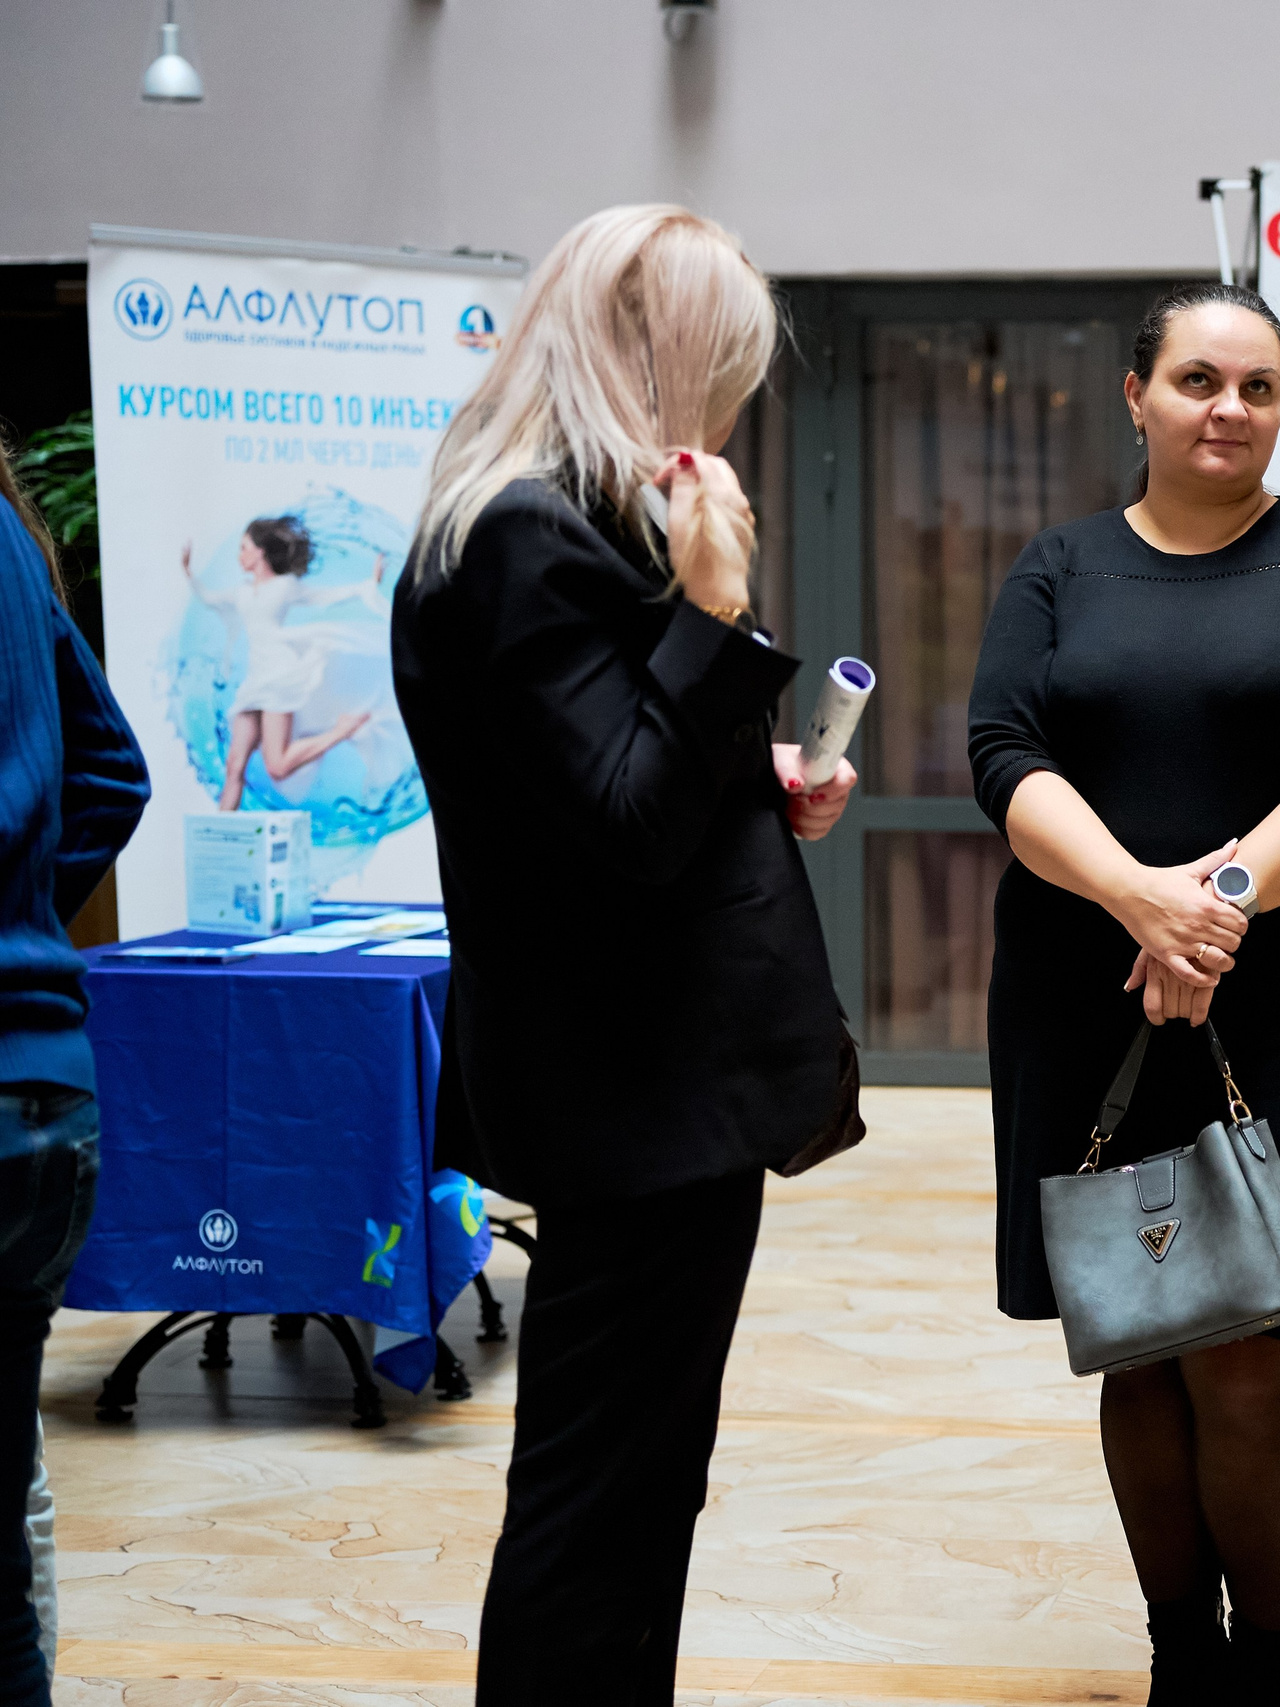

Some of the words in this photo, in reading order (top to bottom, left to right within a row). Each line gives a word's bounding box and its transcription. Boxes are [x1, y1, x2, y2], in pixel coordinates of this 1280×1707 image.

[184, 282, 425, 337] АЛФЛУТОП
[119, 383, 235, 421] КУРСОМ
[243, 388, 323, 425] ВСЕГО
[333, 393, 363, 427] 10
[225, 435, 253, 463] ПО
[257, 436, 268, 464] 2
[274, 438, 304, 465] МЛ
[308, 440, 367, 467] ЧЕРЕЗ
[370, 441, 422, 470] ДЕНЬ
[172, 1255, 264, 1276] АЛФЛУТОП
